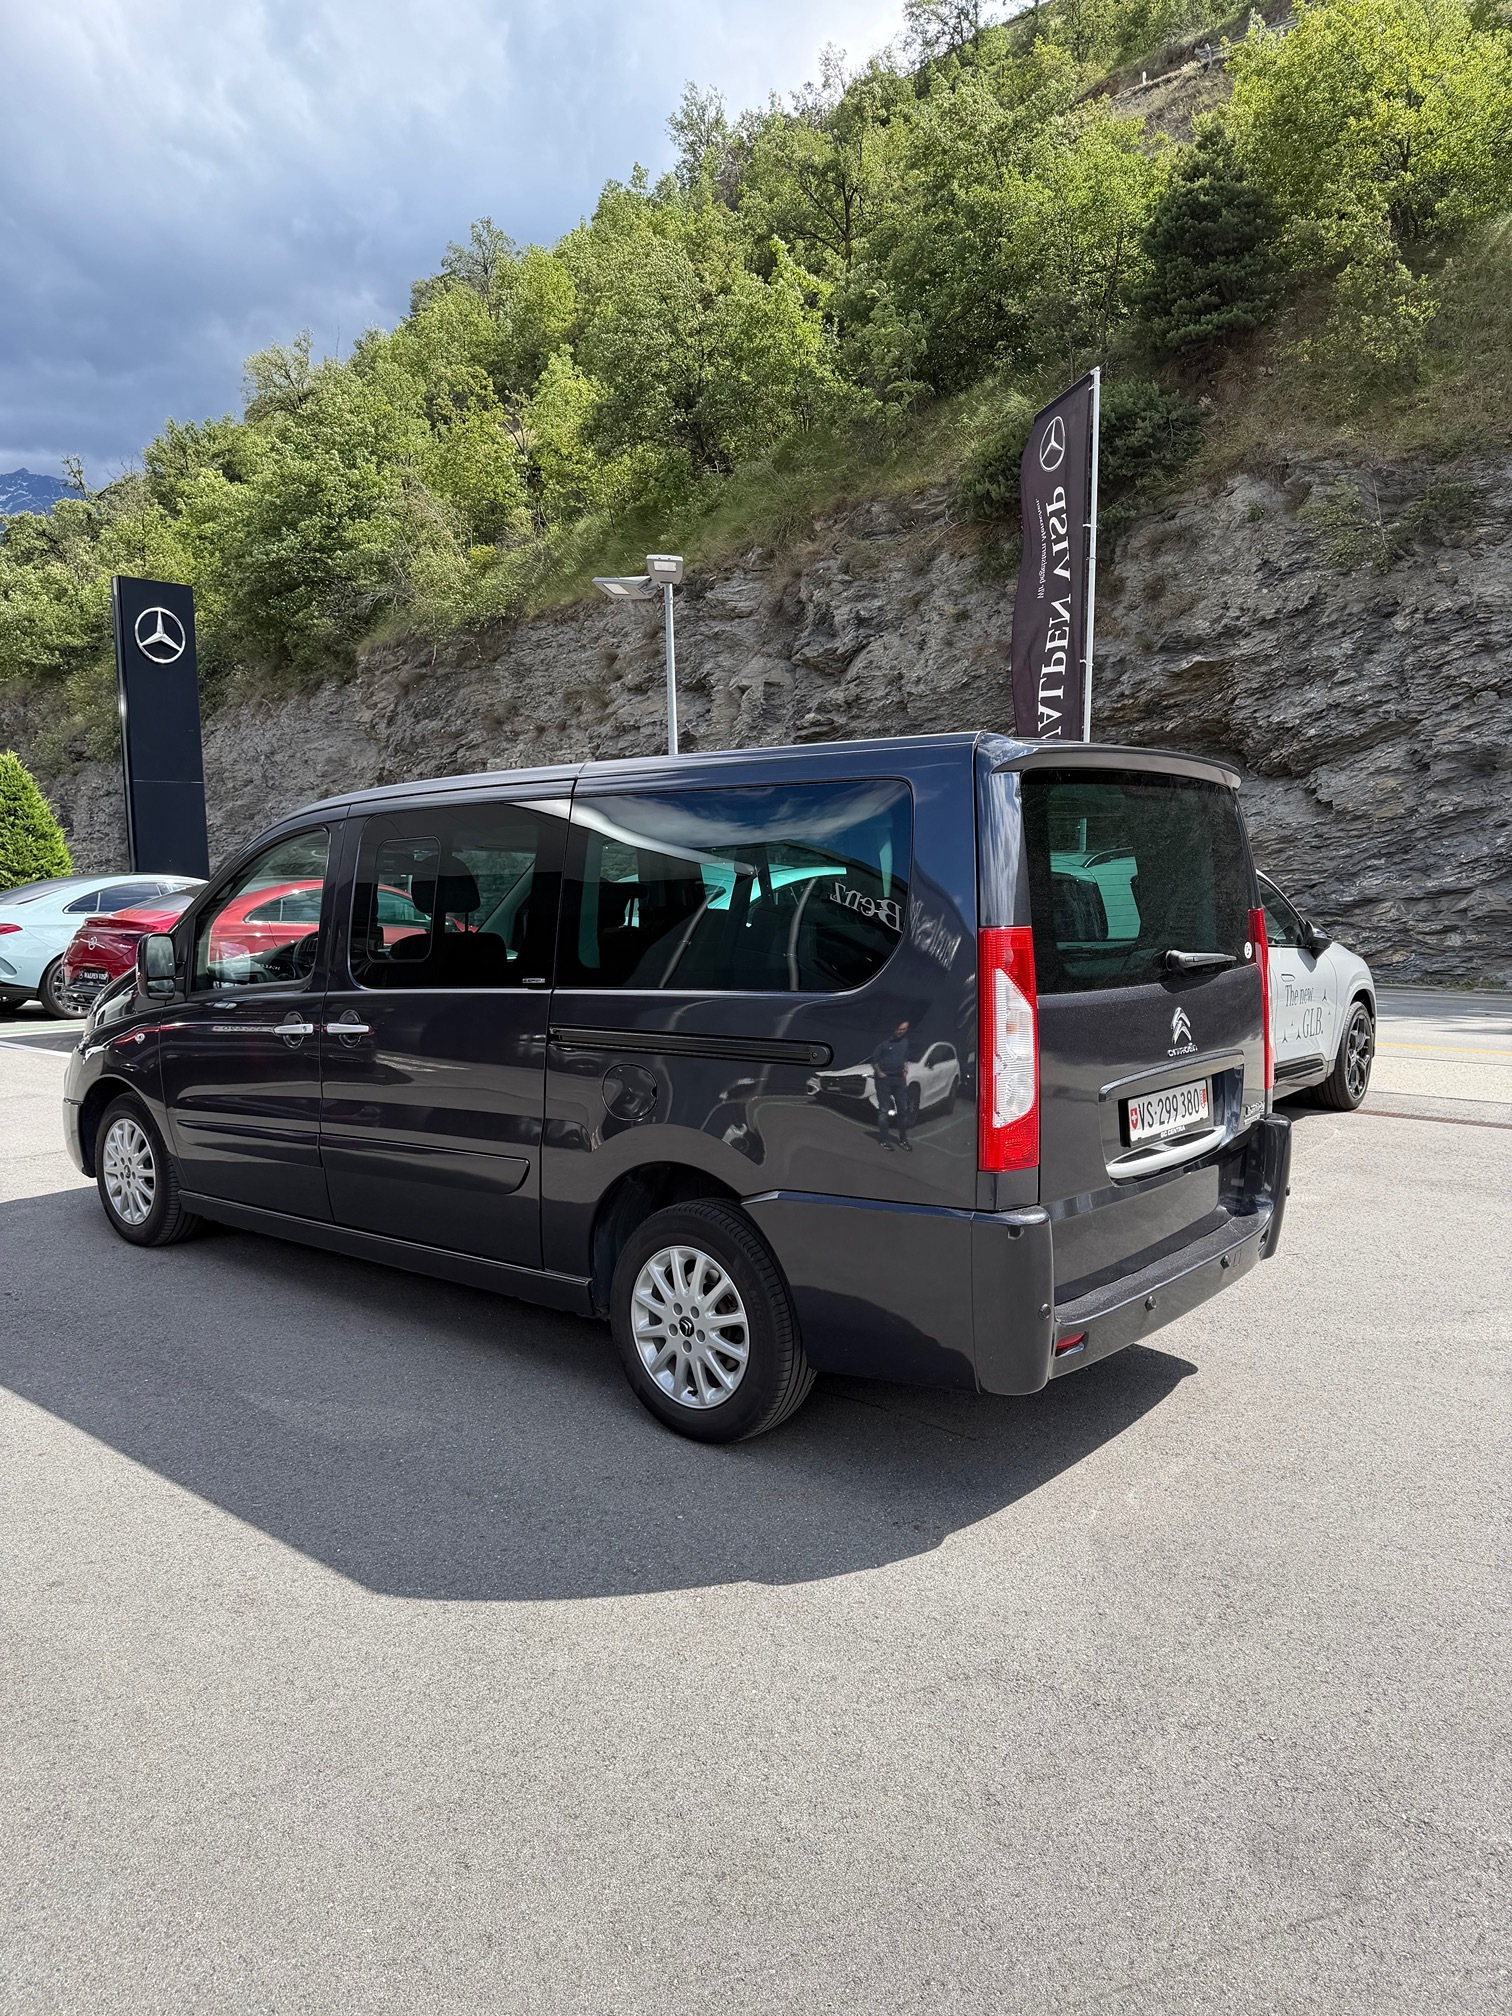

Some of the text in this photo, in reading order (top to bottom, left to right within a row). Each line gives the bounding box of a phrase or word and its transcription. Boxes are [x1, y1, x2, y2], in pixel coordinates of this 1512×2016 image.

[1285, 984, 1314, 1007] The new
[1302, 1007, 1324, 1039] GLB.
